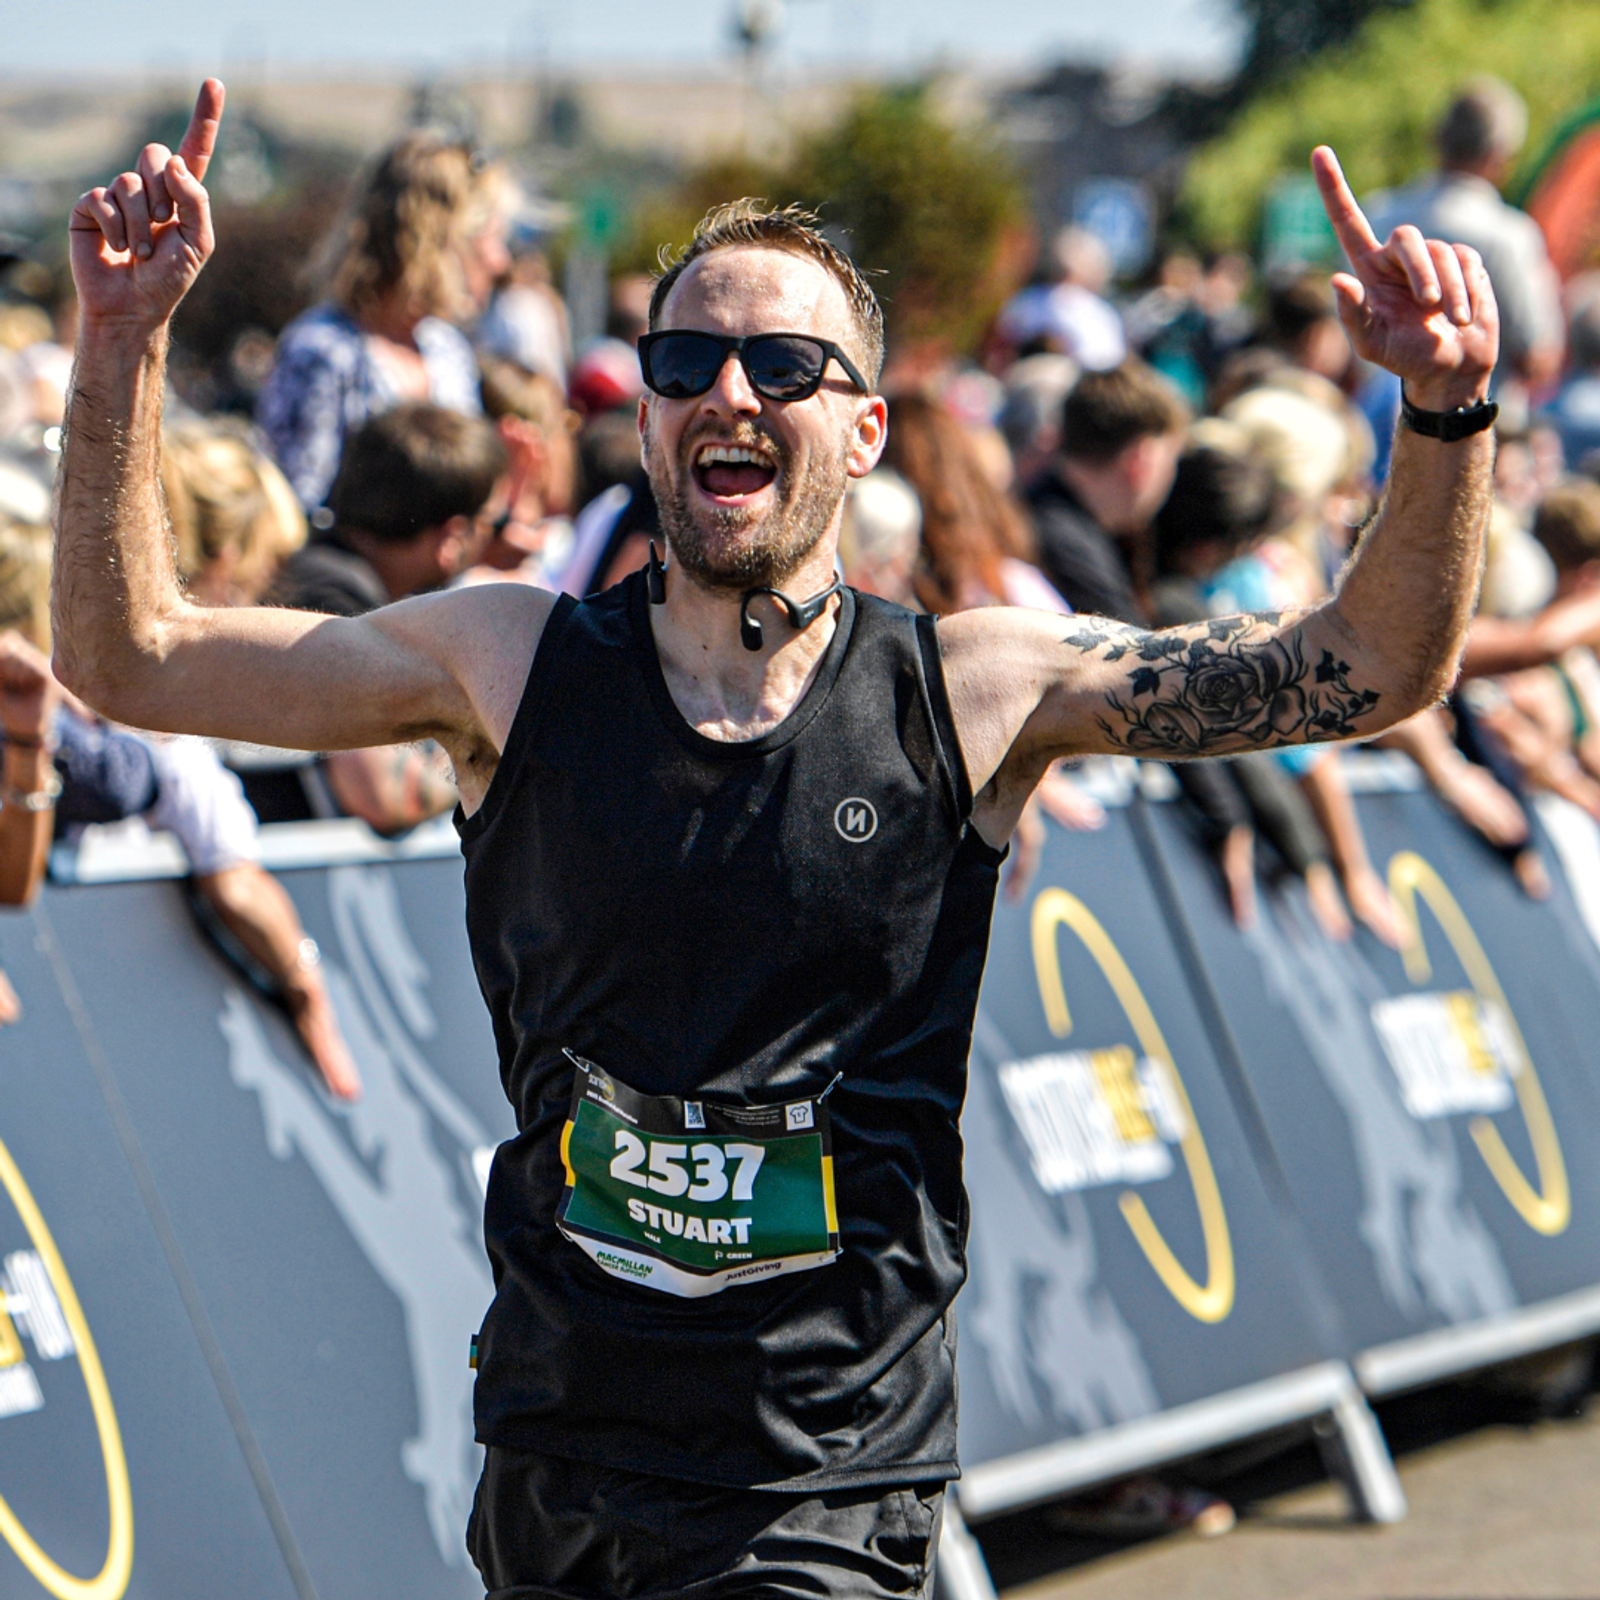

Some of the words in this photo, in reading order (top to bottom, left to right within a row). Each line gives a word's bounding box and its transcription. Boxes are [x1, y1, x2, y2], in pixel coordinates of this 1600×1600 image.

[609, 1130, 766, 1202] 2537
[627, 1197, 753, 1245] STUART
[596, 1250, 653, 1274] MACMILLAN
[726, 1251, 753, 1260] GREEN
[724, 1260, 783, 1282] JustGiving
